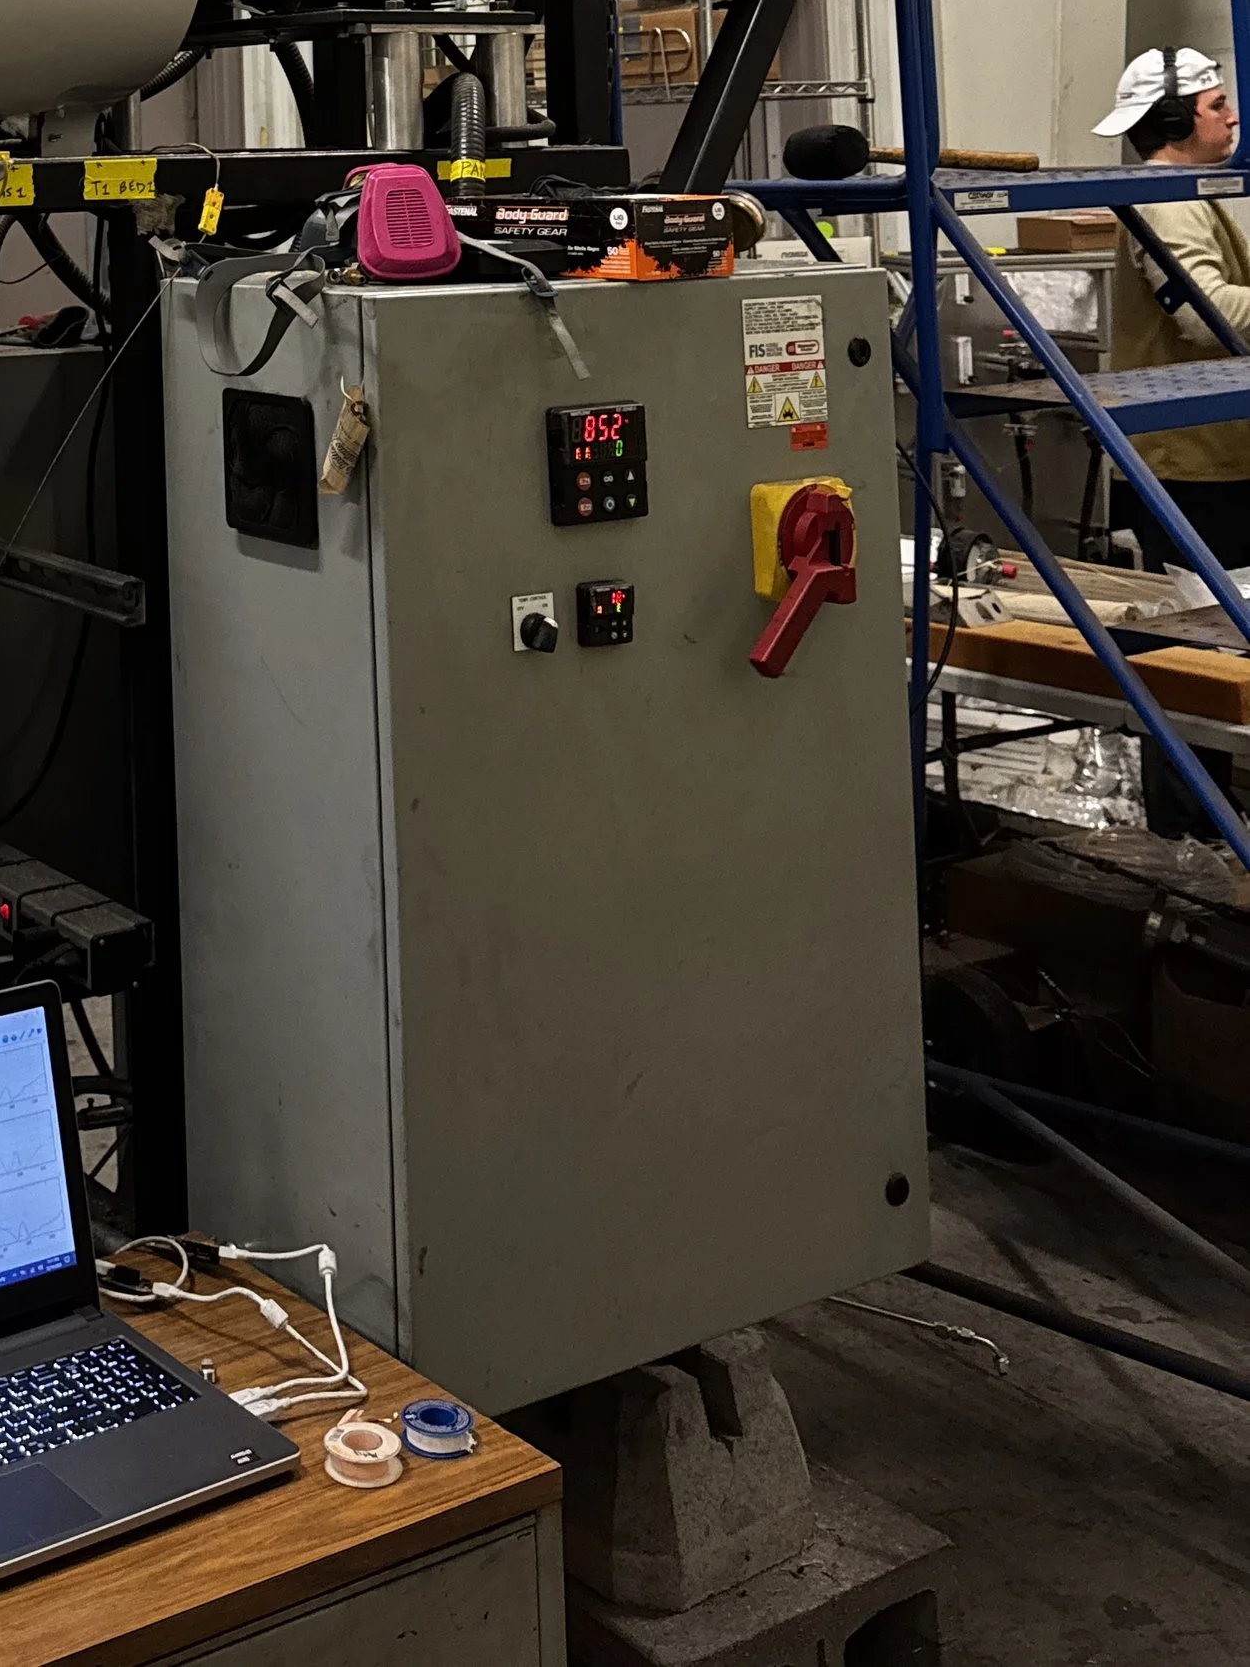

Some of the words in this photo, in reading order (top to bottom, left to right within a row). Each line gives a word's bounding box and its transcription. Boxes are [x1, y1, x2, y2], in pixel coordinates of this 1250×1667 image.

[91, 181, 110, 196] T1
[495, 207, 527, 224] Body
[529, 208, 569, 221] Guard
[664, 215, 684, 226] Body
[684, 214, 705, 224] Guard
[494, 226, 535, 236] SAFETY
[536, 227, 568, 237] GEAR
[663, 226, 687, 234] SAFETY
[607, 246, 619, 256] 50
[749, 343, 766, 358] FIS
[754, 363, 781, 373] DANGER
[791, 361, 817, 371] DANGER
